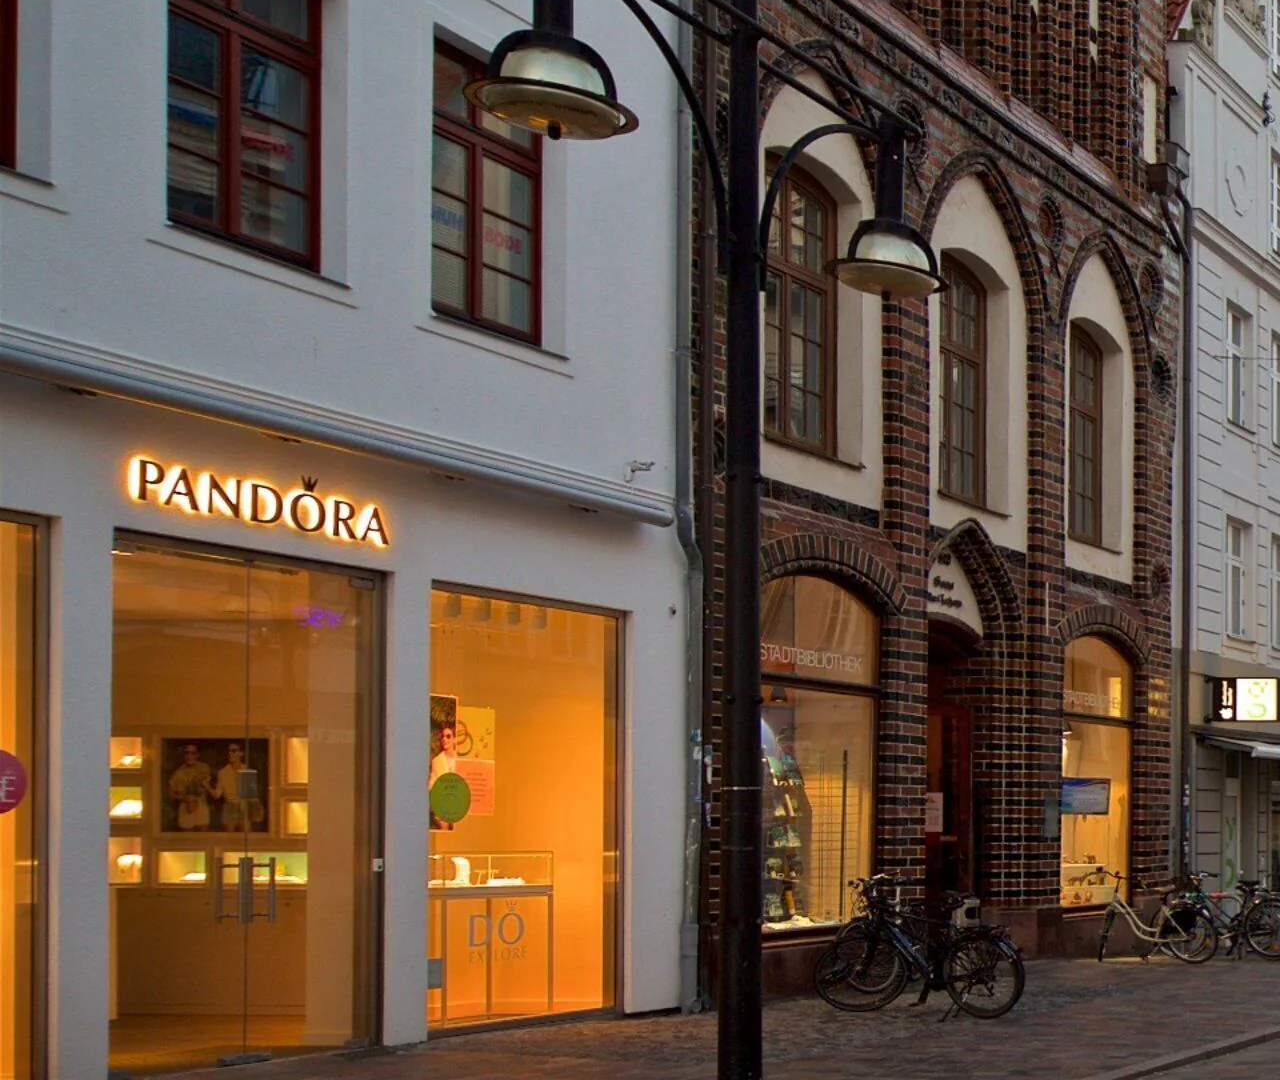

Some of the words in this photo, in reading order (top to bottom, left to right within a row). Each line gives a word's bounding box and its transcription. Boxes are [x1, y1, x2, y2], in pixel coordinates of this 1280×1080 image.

[138, 459, 390, 546] PANDORA
[760, 642, 862, 673] STADTBIBLIOTHEK
[468, 913, 525, 948] DO
